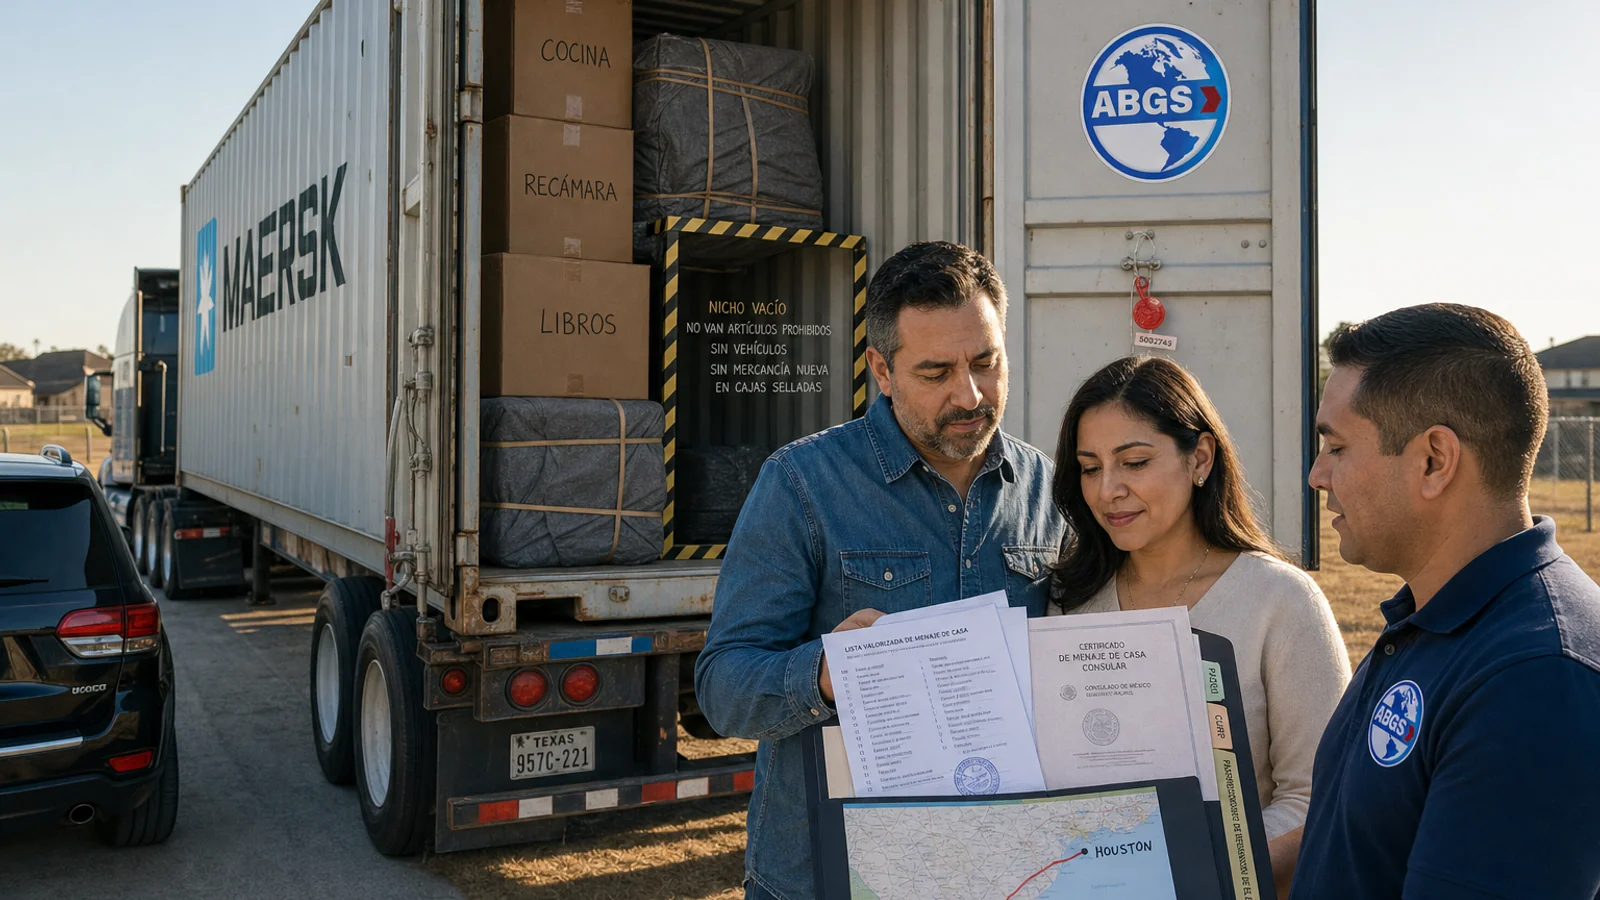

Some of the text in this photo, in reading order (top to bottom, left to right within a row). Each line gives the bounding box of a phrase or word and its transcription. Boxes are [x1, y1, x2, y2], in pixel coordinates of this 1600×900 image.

[541, 38, 611, 69] COCINA
[1091, 85, 1193, 119] ABGS
[524, 173, 618, 202] RECÁMARA
[223, 162, 348, 332] MAERSK
[709, 298, 787, 315] NICHO VACÍO
[540, 308, 617, 336] LIBROS
[686, 321, 832, 336] NO VAN ARTÍCULOS PROHIBIDOS
[710, 340, 788, 355] SIN VEHÍCULOS
[710, 361, 829, 376] SIN MERCANCÍA NUEVA
[715, 381, 823, 393] EN CAJAS SELLADAS
[844, 643, 863, 653] LISTA
[863, 637, 904, 651] VALORIZADA
[904, 635, 915, 644] DE
[914, 631, 941, 642] MENAJE
[941, 630, 951, 639] DE
[951, 627, 969, 636] CASA
[1079, 641, 1126, 651] CERTIFICADO
[1058, 650, 1147, 662] DE MENAJE DE CASA
[1082, 662, 1128, 672] CONSULAR
[1374, 705, 1407, 736] ABGS
[533, 733, 575, 748] TEXAS
[517, 747, 589, 774] 957C-221
[1095, 840, 1153, 858] HOUSTON
